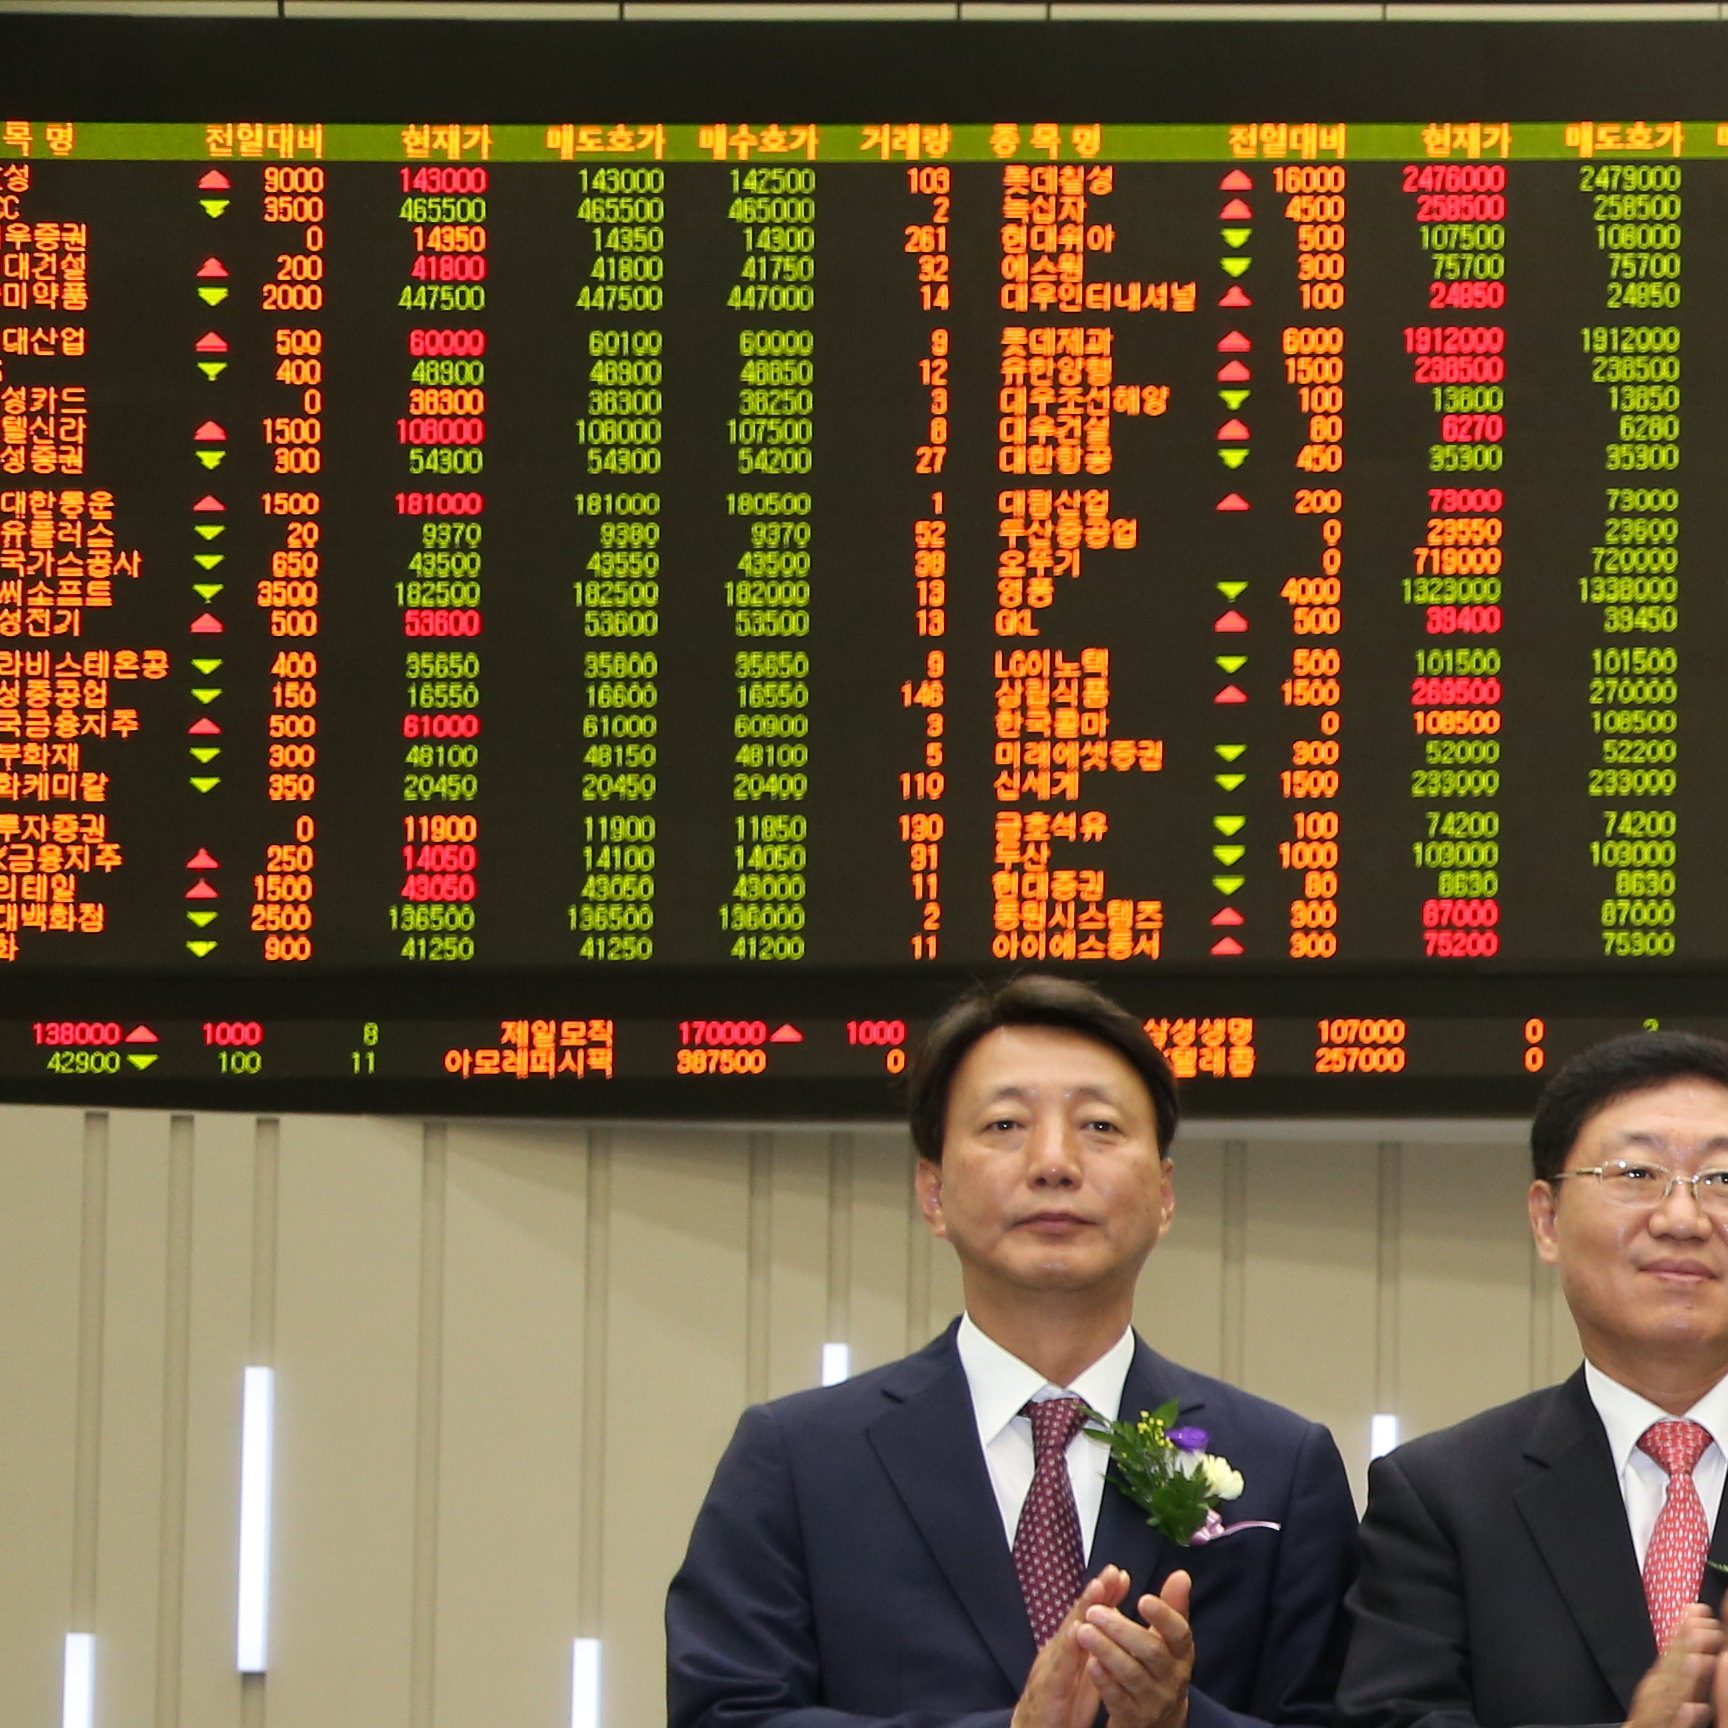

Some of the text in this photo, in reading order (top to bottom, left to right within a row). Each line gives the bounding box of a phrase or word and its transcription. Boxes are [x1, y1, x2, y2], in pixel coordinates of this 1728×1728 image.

[46, 123, 73, 155] 명
[206, 123, 322, 158] 전일대비
[402, 125, 492, 160] 현재가
[546, 124, 666, 159] 매도호가
[699, 124, 819, 160] 매수호가
[861, 124, 951, 159] 거래량
[1229, 123, 1345, 159] 전일대비
[1422, 123, 1512, 158] 현재가
[1565, 122, 1684, 157] 매도호가
[263, 166, 326, 193] 9000
[262, 283, 324, 310] 2000
[1416, 648, 1500, 675] 101500
[203, 1022, 263, 1046] 1000
[679, 1021, 769, 1046] 170000
[847, 1020, 907, 1046] 1000
[1318, 1019, 1406, 1044] 107000
[221, 1047, 613, 1079] 100 11 아모레퍼시픽
[1315, 1047, 1405, 1072] 257000
